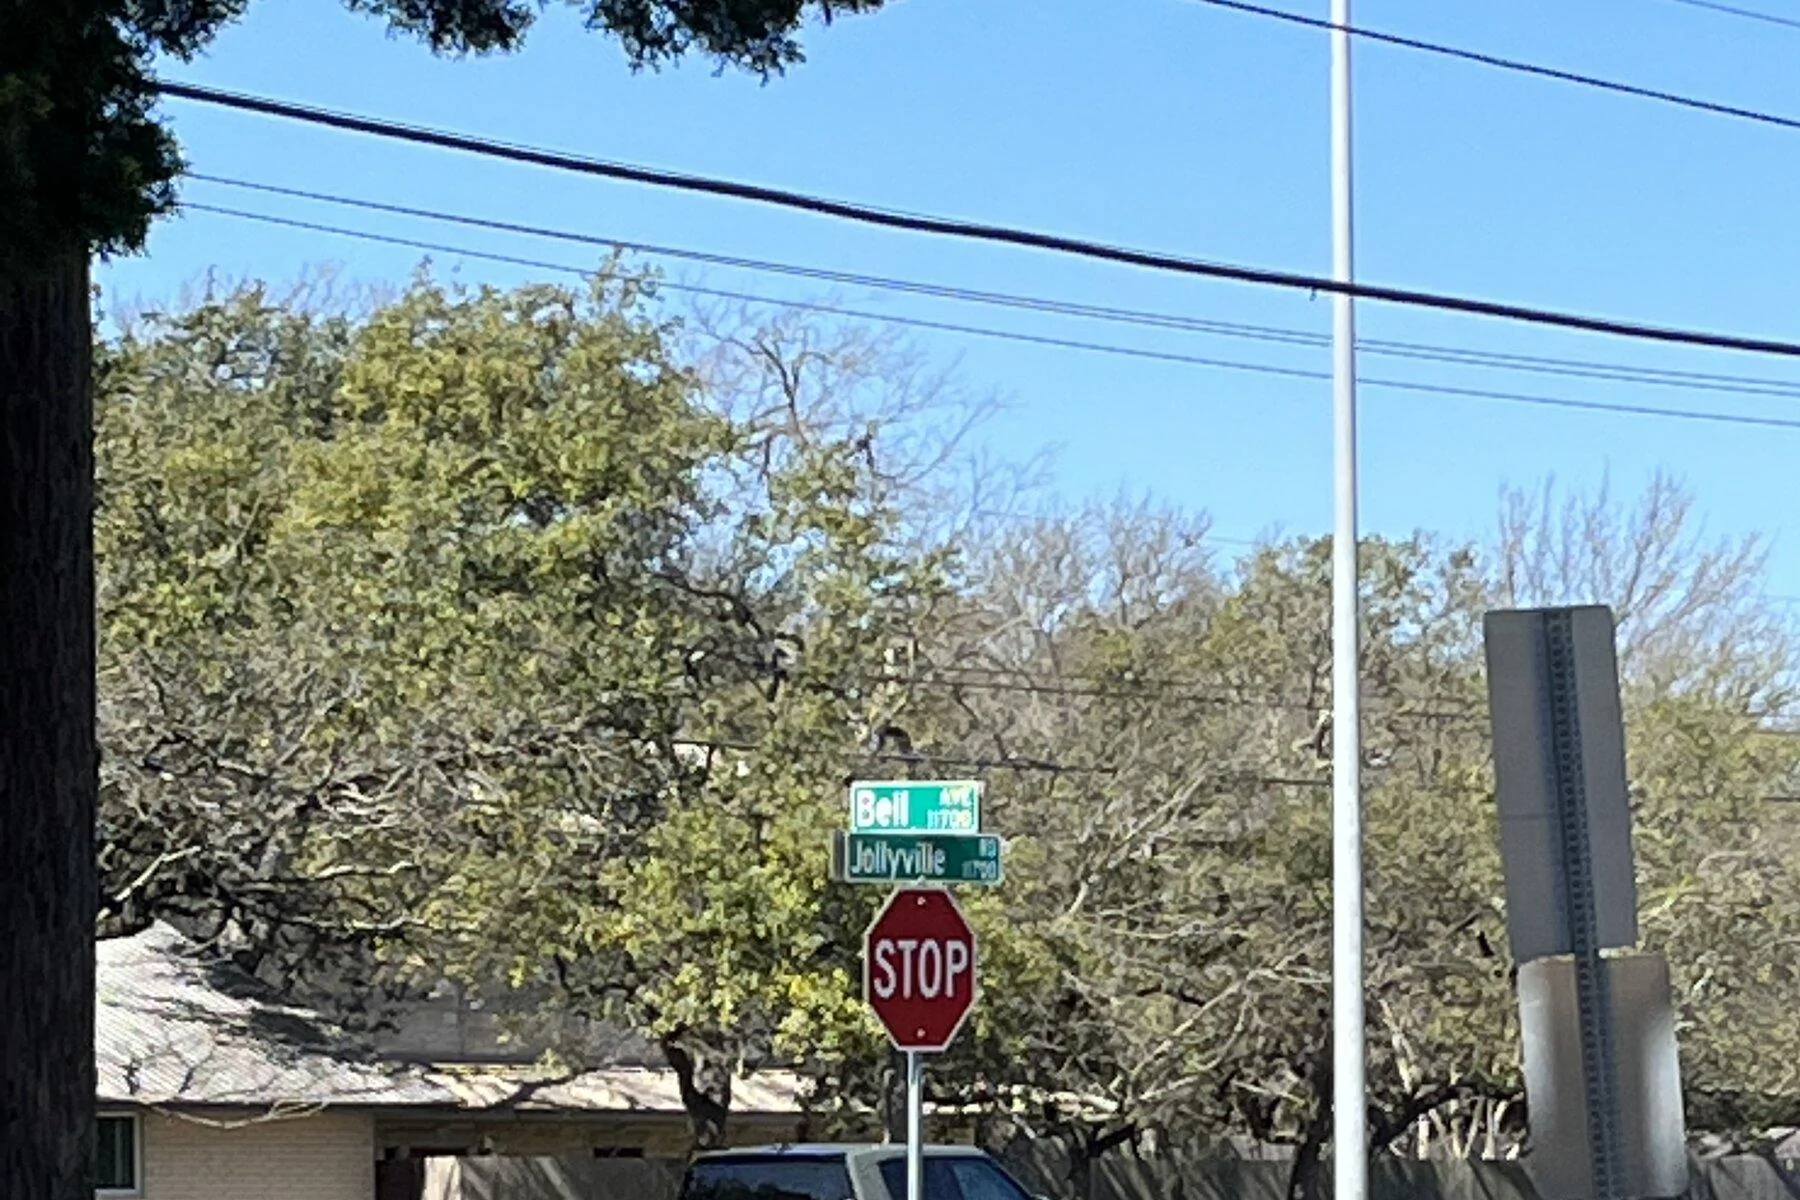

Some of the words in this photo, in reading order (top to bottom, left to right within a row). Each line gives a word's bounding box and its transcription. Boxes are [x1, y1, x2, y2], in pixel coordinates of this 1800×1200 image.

[857, 789, 910, 828] Bell
[852, 840, 947, 880] Jollyville
[874, 938, 968, 999] STOP
